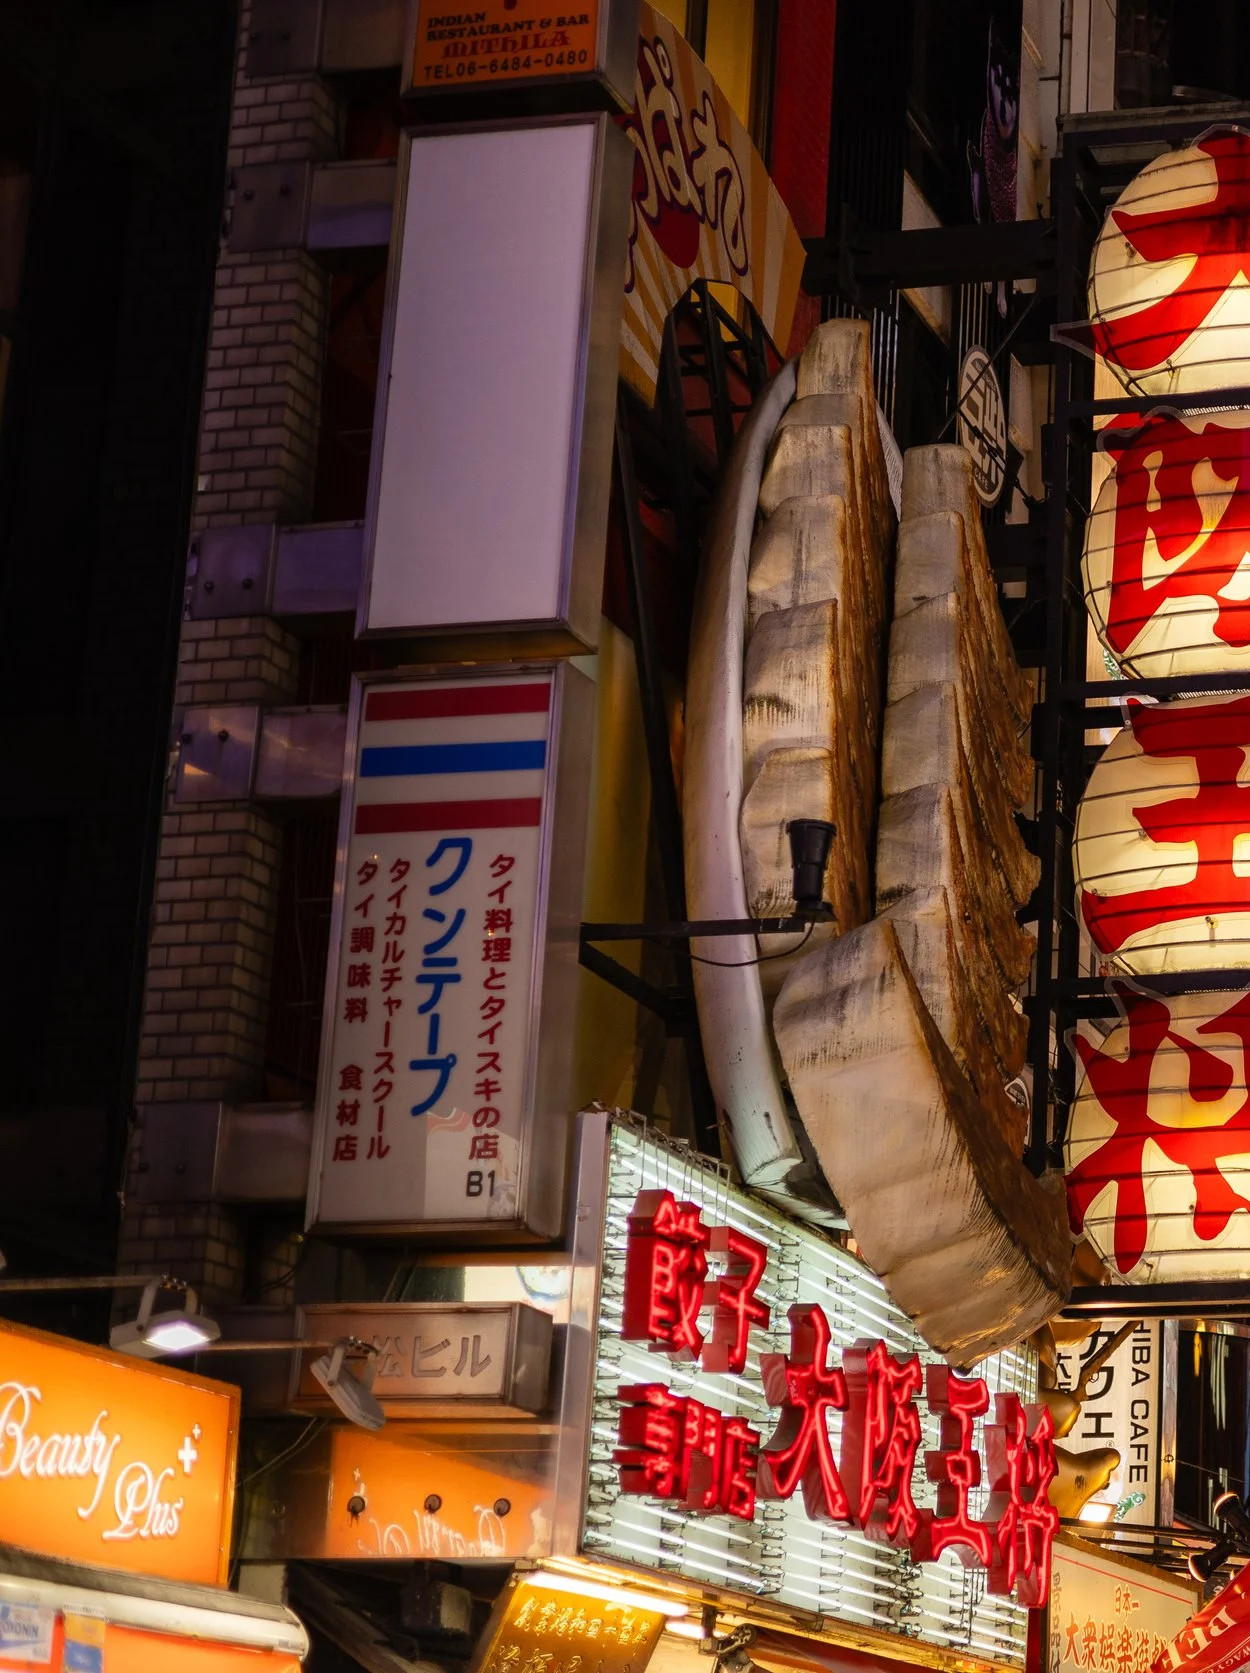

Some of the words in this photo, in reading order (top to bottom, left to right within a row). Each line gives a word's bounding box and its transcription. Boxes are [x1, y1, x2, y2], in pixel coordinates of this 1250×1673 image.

[427, 20, 535, 41] RESTAURANT
[539, 18, 552, 29] &
[556, 14, 590, 27] BAR
[428, 13, 486, 28] INDIAN
[343, 860, 378, 1025] タイ調味料
[410, 837, 473, 1117] クンテープ
[366, 858, 411, 1160] タイカルチャースクール
[469, 854, 515, 1160] タイ料理とタイスキの店
[333, 1063, 363, 1162] 食材店
[466, 1171, 495, 1198] B1
[623, 1189, 770, 1374] 餃子
[0, 1381, 121, 1519] Beauty
[1129, 1400, 1149, 1483] CAFE
[102, 1462, 183, 1539] Plus
[1115, 1585, 1139, 1617] 日本一
